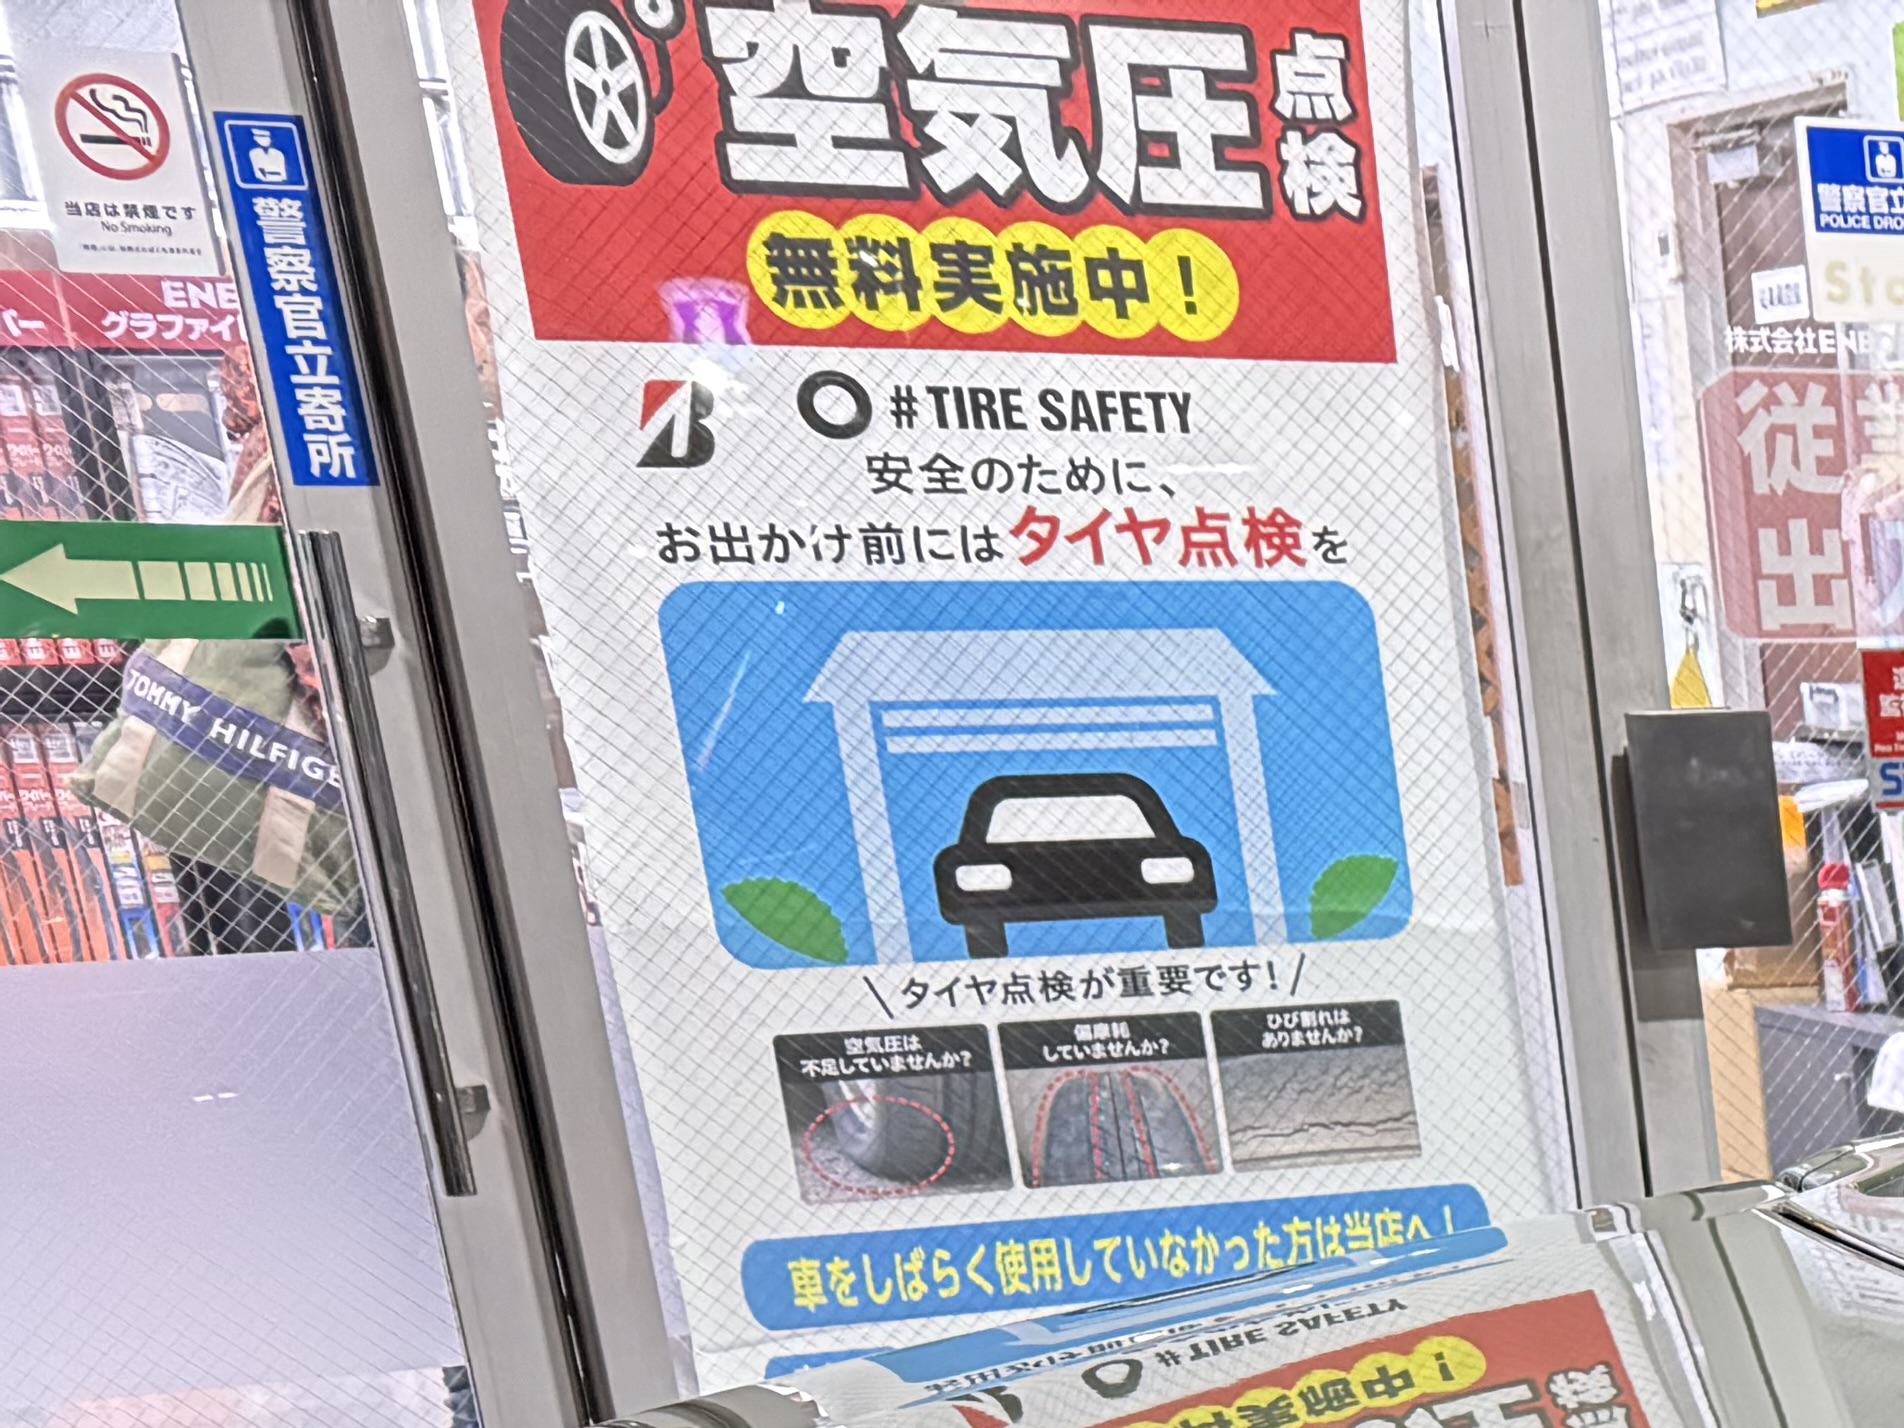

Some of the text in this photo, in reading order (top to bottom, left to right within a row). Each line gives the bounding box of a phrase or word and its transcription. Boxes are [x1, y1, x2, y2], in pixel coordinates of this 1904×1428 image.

[698, 0, 1268, 214] 空気圧
[1270, 33, 1367, 221] 点検
[63, 199, 197, 222] 当店は禁煙です
[100, 221, 173, 236] No Smoking
[1819, 213, 1872, 230] POLICE
[762, 231, 1201, 320] 無料実施中！
[252, 196, 357, 480] 警察官立寄所
[1038, 387, 1193, 435] SAFETY
[865, 452, 1178, 498] 安全のために、
[655, 504, 1350, 568] お出かけ前にはタイヤ点検を
[126, 667, 205, 724] TOMMY
[900, 959, 1278, 1011] タイヤ点検が重要です！
[1261, 1026, 1364, 1049] ありませんか？
[1265, 1010, 1352, 1031] ひび割れは
[800, 1050, 973, 1078] 不足していませんか？
[843, 1033, 922, 1056] 空気圧は
[1041, 1038, 1171, 1062] していませんか？
